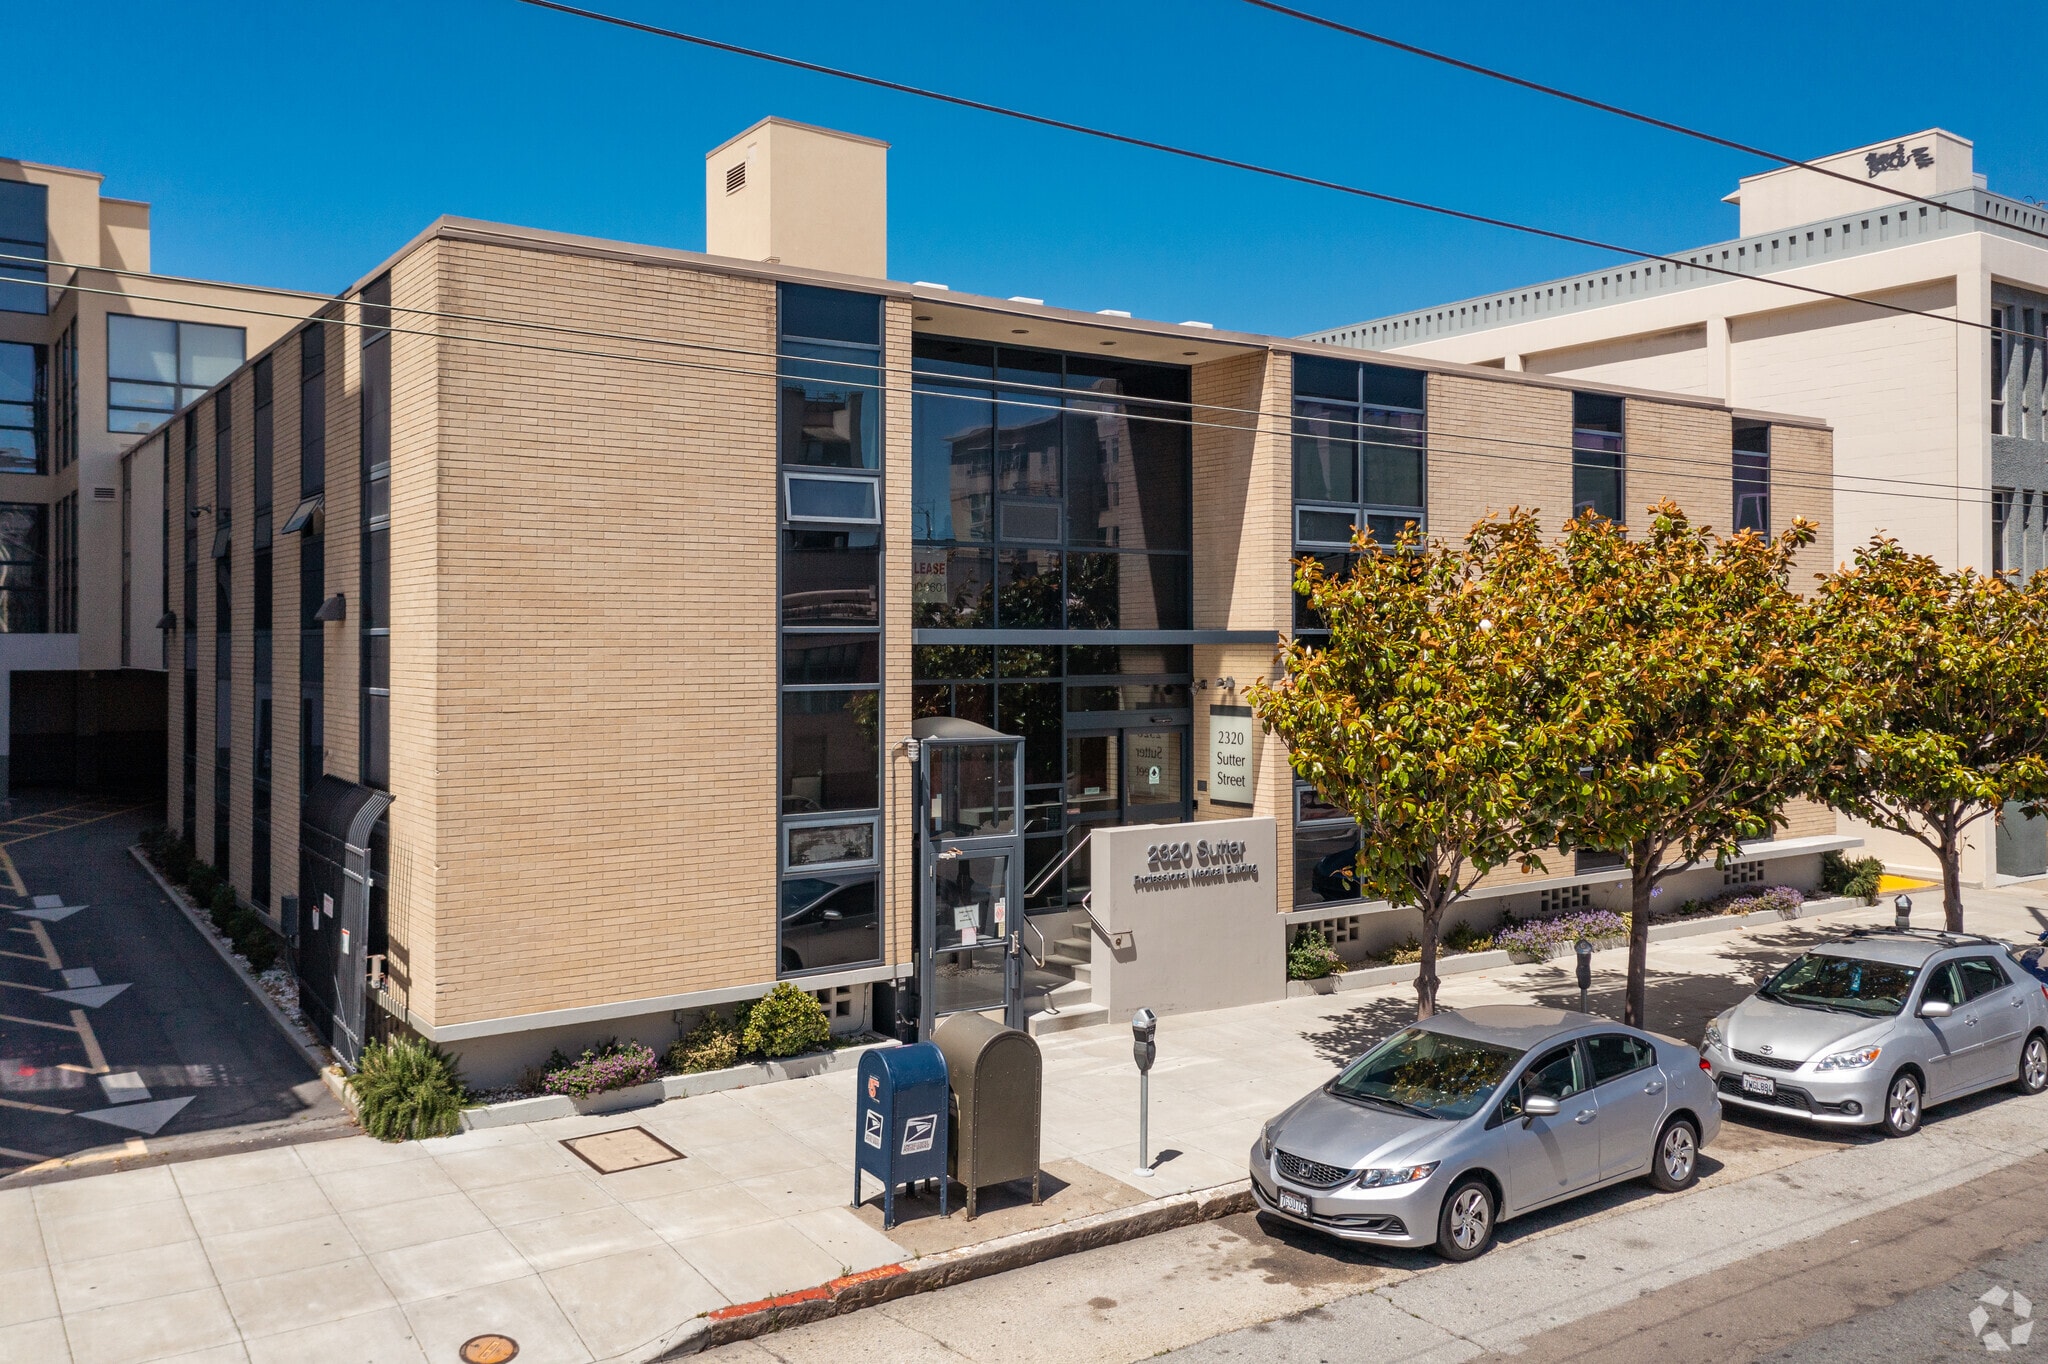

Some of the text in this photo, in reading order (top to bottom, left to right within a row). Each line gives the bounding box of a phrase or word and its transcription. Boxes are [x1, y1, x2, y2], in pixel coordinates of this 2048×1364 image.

[914, 562, 946, 575] LEASE
[1218, 730, 1244, 746] 2320
[1217, 751, 1246, 767] Sutter
[1217, 771, 1246, 788] Street
[1147, 839, 1247, 865] 2320 Sutter
[1134, 863, 1259, 888] Professional Medical Building
